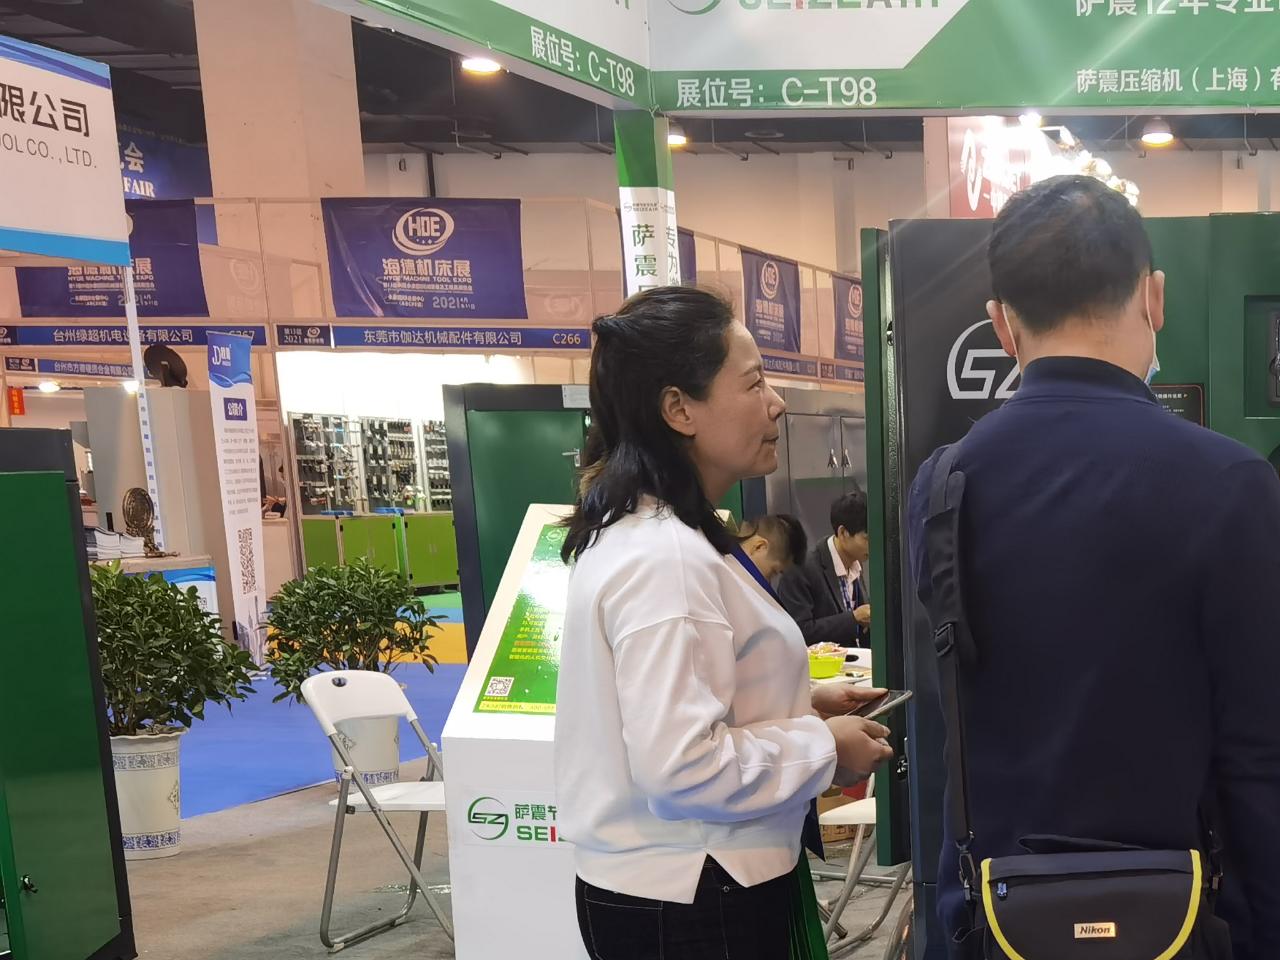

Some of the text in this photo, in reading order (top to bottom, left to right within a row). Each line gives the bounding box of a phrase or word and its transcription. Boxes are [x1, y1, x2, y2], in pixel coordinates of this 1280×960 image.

[382, 258, 472, 277] 海德机床展
[552, 333, 581, 345] C266
[516, 825, 566, 843] SEI
[1080, 925, 1111, 935] Nikon
